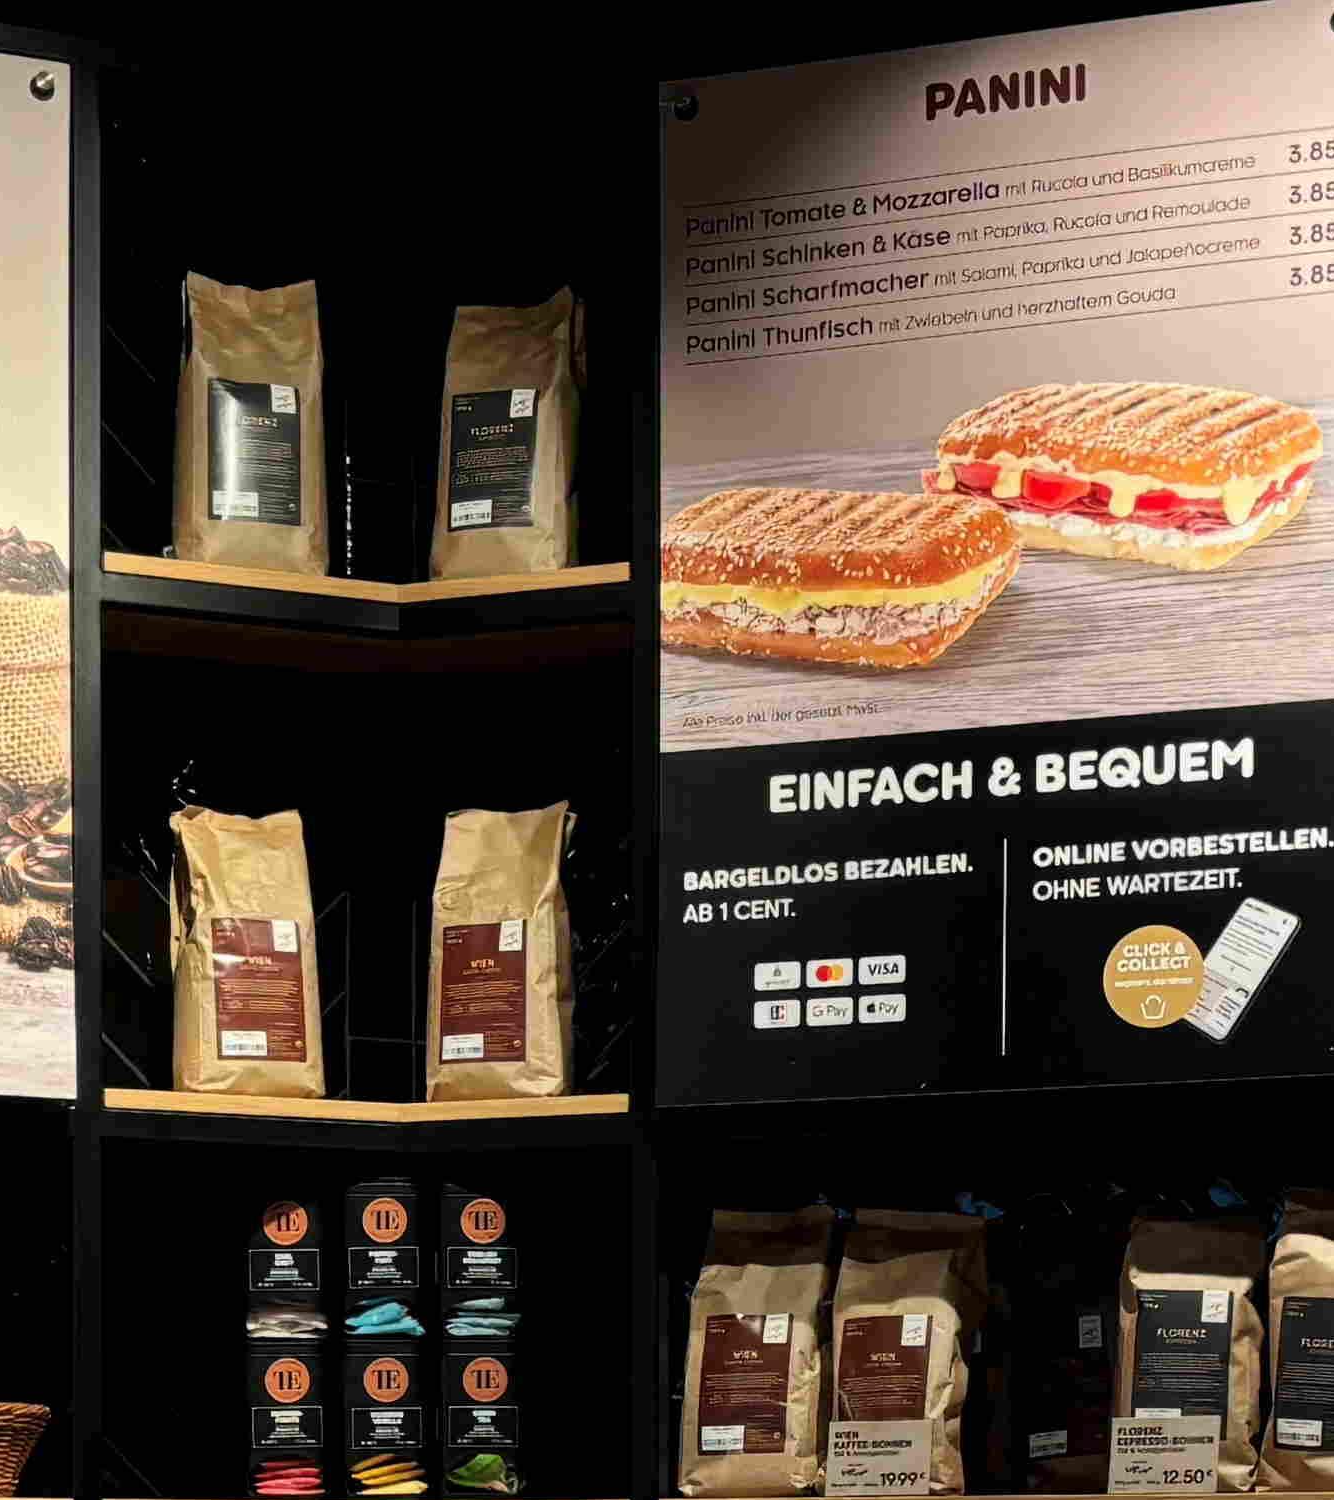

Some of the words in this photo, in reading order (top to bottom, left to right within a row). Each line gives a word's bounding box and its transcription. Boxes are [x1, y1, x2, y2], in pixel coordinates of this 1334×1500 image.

[925, 63, 1088, 121] PANINI
[686, 212, 755, 237] Panini
[759, 202, 845, 231] Tomate
[852, 198, 867, 216] &
[873, 181, 1000, 214] Mozzarella
[1092, 169, 1124, 186] und
[686, 252, 755, 278] Panini
[762, 240, 864, 269] Schinken
[873, 236, 887, 253] &
[1115, 207, 1148, 224] und
[686, 291, 755, 316] Panini
[763, 272, 930, 307] Scharfmacher
[1089, 251, 1122, 268] und
[686, 331, 756, 355] Panini
[763, 316, 873, 347] Thunfisch
[981, 305, 1013, 322] und
[769, 759, 974, 813] EINFACH
[988, 756, 1022, 797] &
[1035, 738, 1255, 794] BEQUEM
[1033, 840, 1126, 869] ONLINE
[1131, 827, 1334, 862] VORBESTELLEN.
[683, 861, 838, 892] BARGELDLOS
[844, 852, 974, 882] BEZAHLEN.
[1032, 877, 1100, 901] OHNE
[1107, 868, 1242, 896] WARTEZEIT.
[683, 901, 714, 924] AB
[719, 901, 729, 922] 1
[734, 897, 796, 921] CENT.
[1117, 957, 1191, 972] COLLECT
[1123, 942, 1170, 958] CLICK
[868, 963, 899, 976] VISA
[827, 1005, 848, 1018] Pay
[1156, 1328, 1207, 1339] FLORENZ
[1117, 1427, 1163, 1435] FLORENZ
[1163, 1469, 1212, 1484] 12.50€
